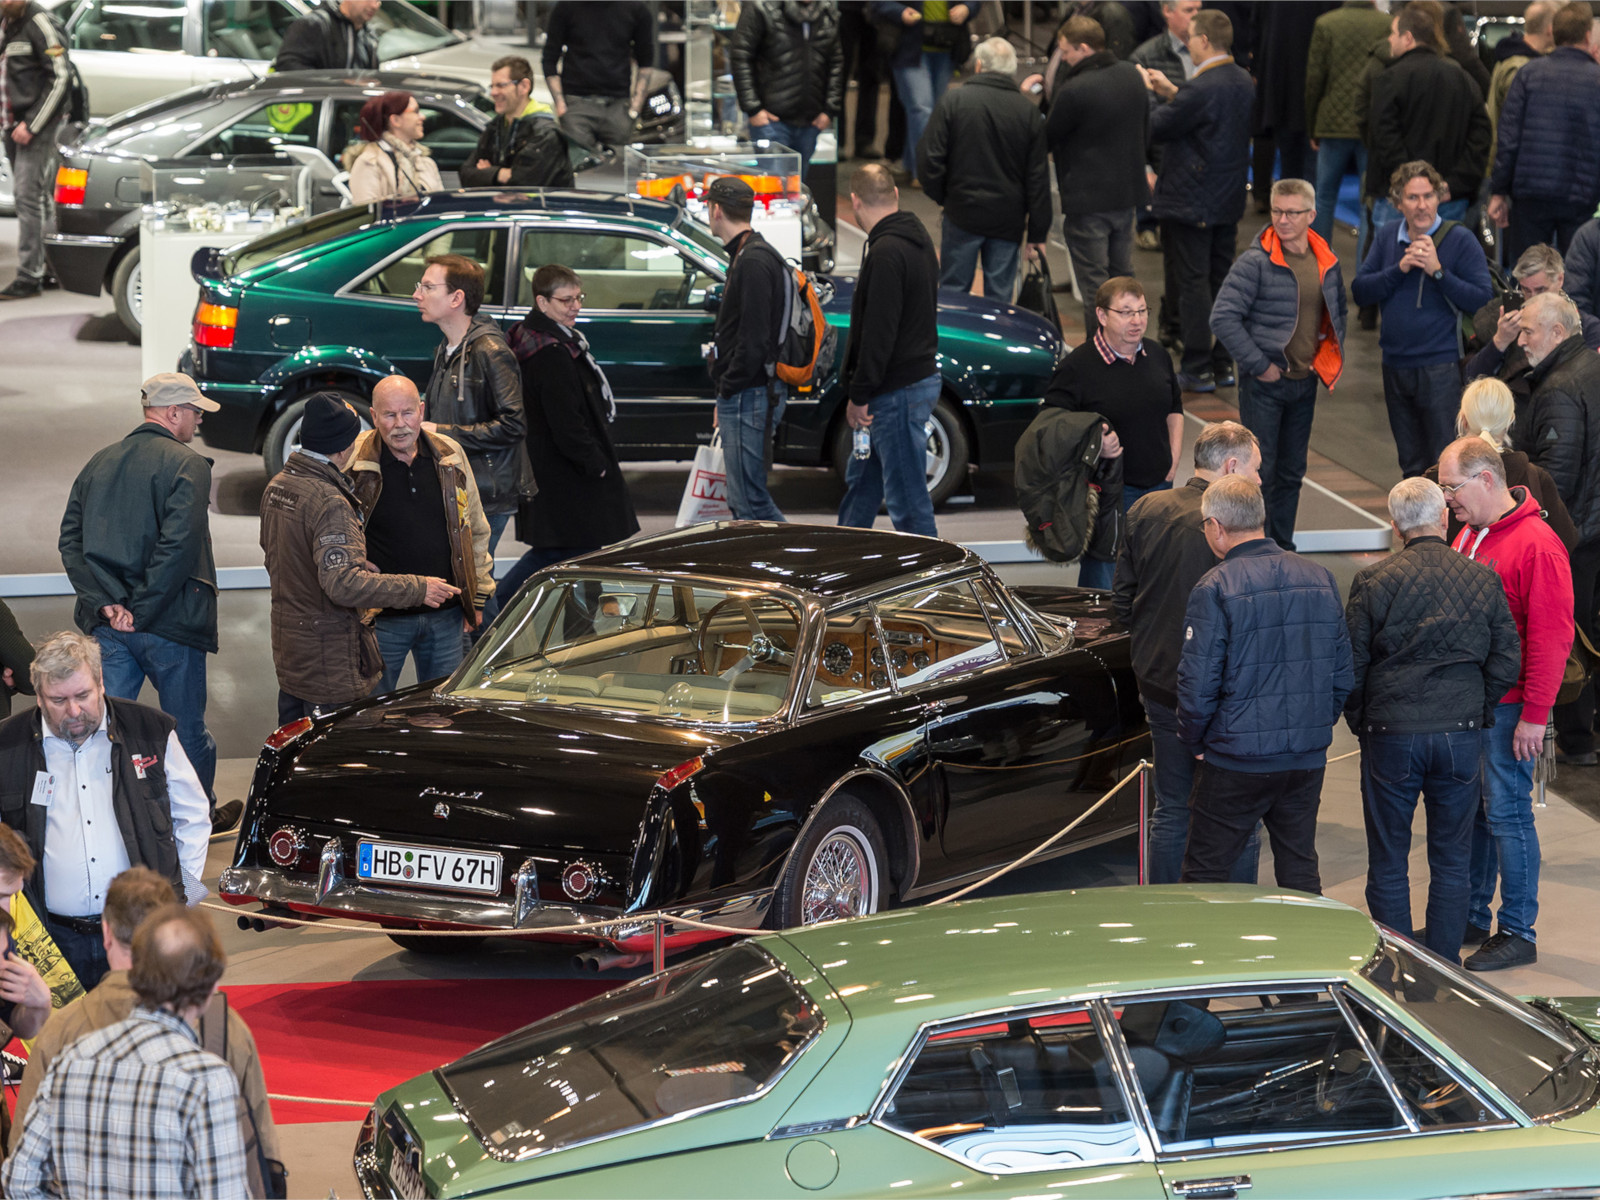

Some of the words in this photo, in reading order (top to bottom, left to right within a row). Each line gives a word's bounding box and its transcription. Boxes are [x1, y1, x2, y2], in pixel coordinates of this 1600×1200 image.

[373, 849, 402, 876] HB
[418, 854, 447, 881] FV
[452, 857, 495, 886] 67H
